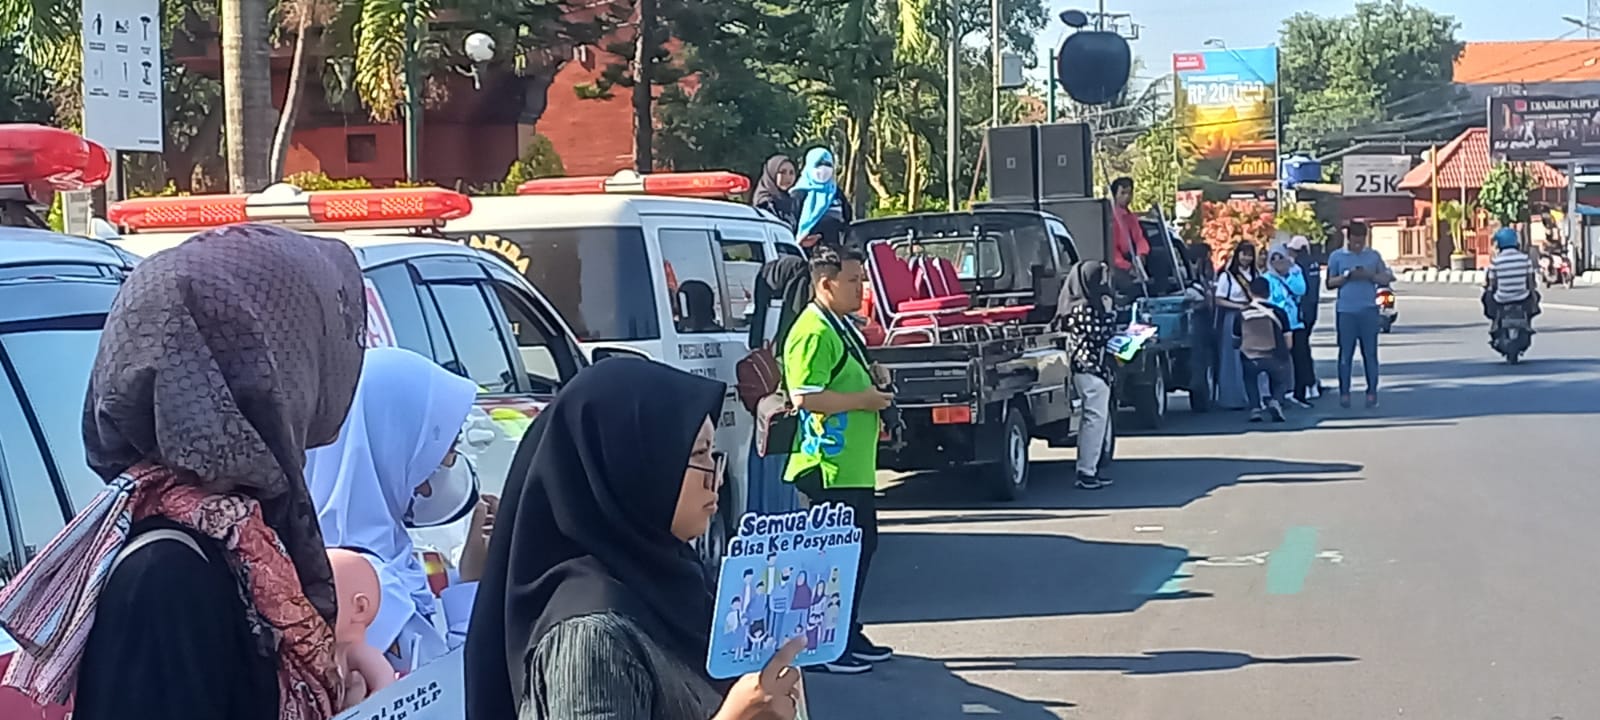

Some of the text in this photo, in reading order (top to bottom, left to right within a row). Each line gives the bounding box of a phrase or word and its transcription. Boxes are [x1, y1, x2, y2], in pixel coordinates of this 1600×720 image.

[1355, 174, 1397, 193] 25K
[741, 505, 852, 536] Semua Usia
[731, 529, 861, 557] Bisa Ke Posyandu
[393, 681, 438, 711] Buka
[413, 689, 442, 712] ILP
